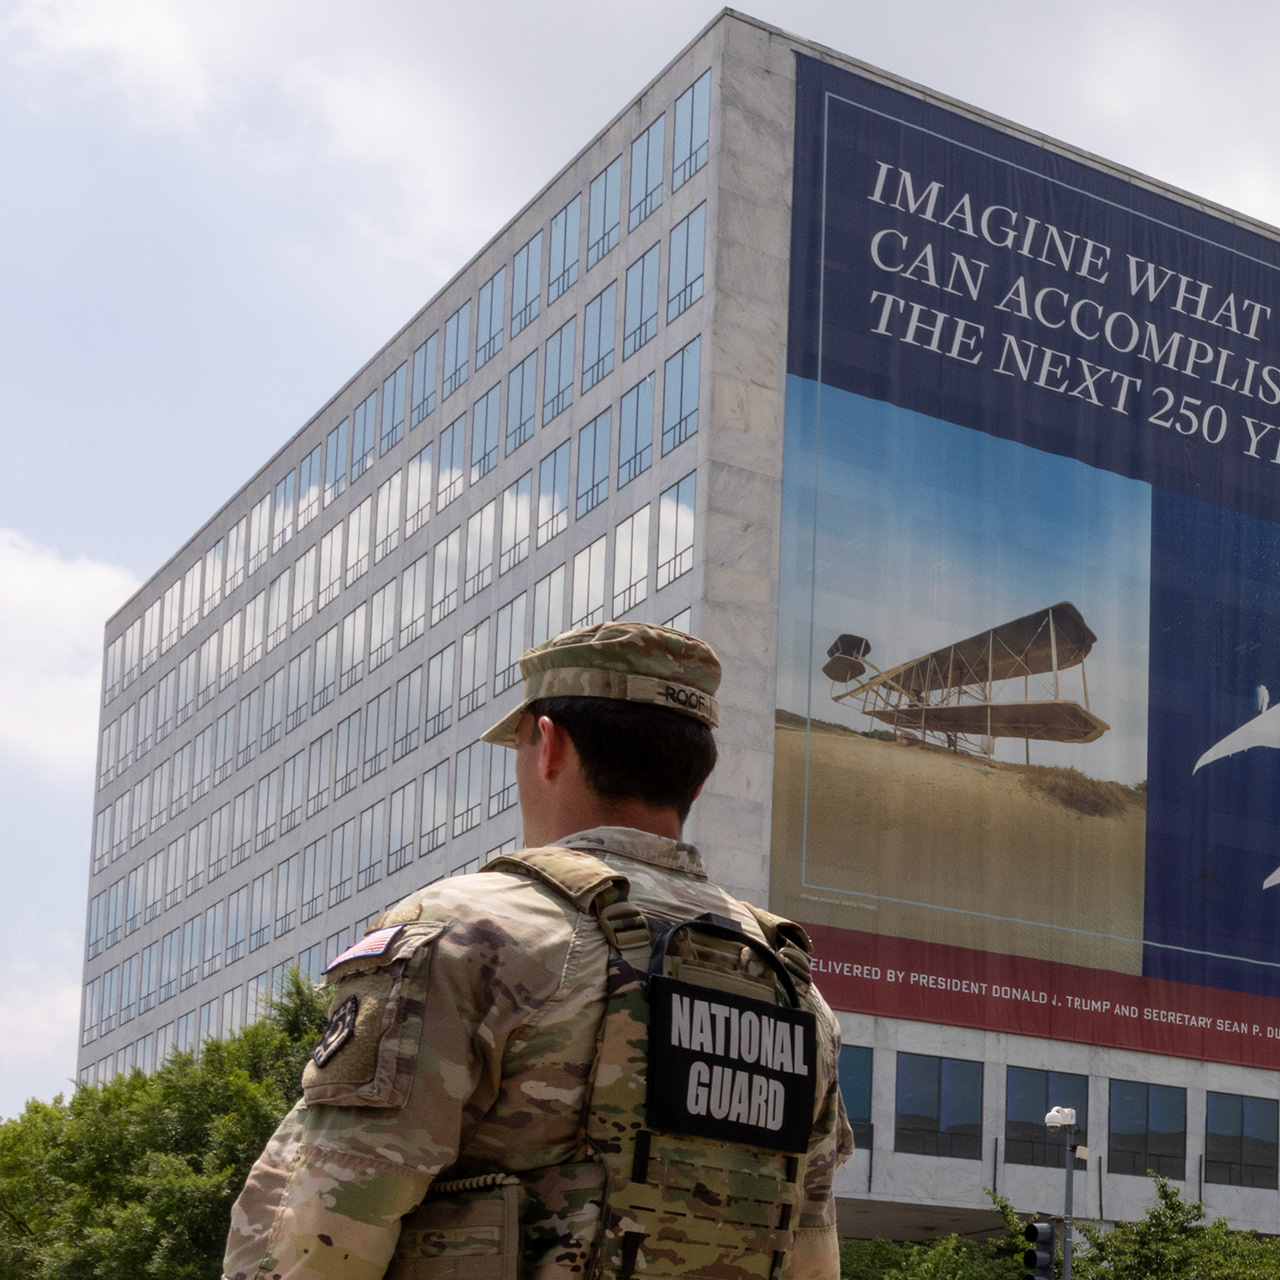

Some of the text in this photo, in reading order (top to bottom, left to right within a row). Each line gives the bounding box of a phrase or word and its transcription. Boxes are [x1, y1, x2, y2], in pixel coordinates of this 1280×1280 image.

[867, 160, 1112, 285] IMAGINE
[1125, 253, 1271, 342] WHAT
[870, 228, 990, 302] CAN
[869, 290, 986, 365] THE
[993, 333, 1141, 415] NEXT
[1147, 386, 1227, 445] 250
[665, 686, 706, 709] ROOF
[670, 994, 809, 1076] NATIONAL
[810, 958, 881, 980] ELIVERED
[886, 969, 905, 983] BY
[910, 972, 988, 996] PRESIDENT
[992, 985, 1047, 1004] DONALD
[1052, 994, 1062, 1006] J.
[1066, 996, 1111, 1013] TRUMP
[1114, 1004, 1138, 1018] AND
[1144, 1008, 1212, 1029] SECRETARY
[1216, 1019, 1248, 1034] SEAN
[1253, 1025, 1262, 1037] P.
[686, 1061, 786, 1132] GUARD
